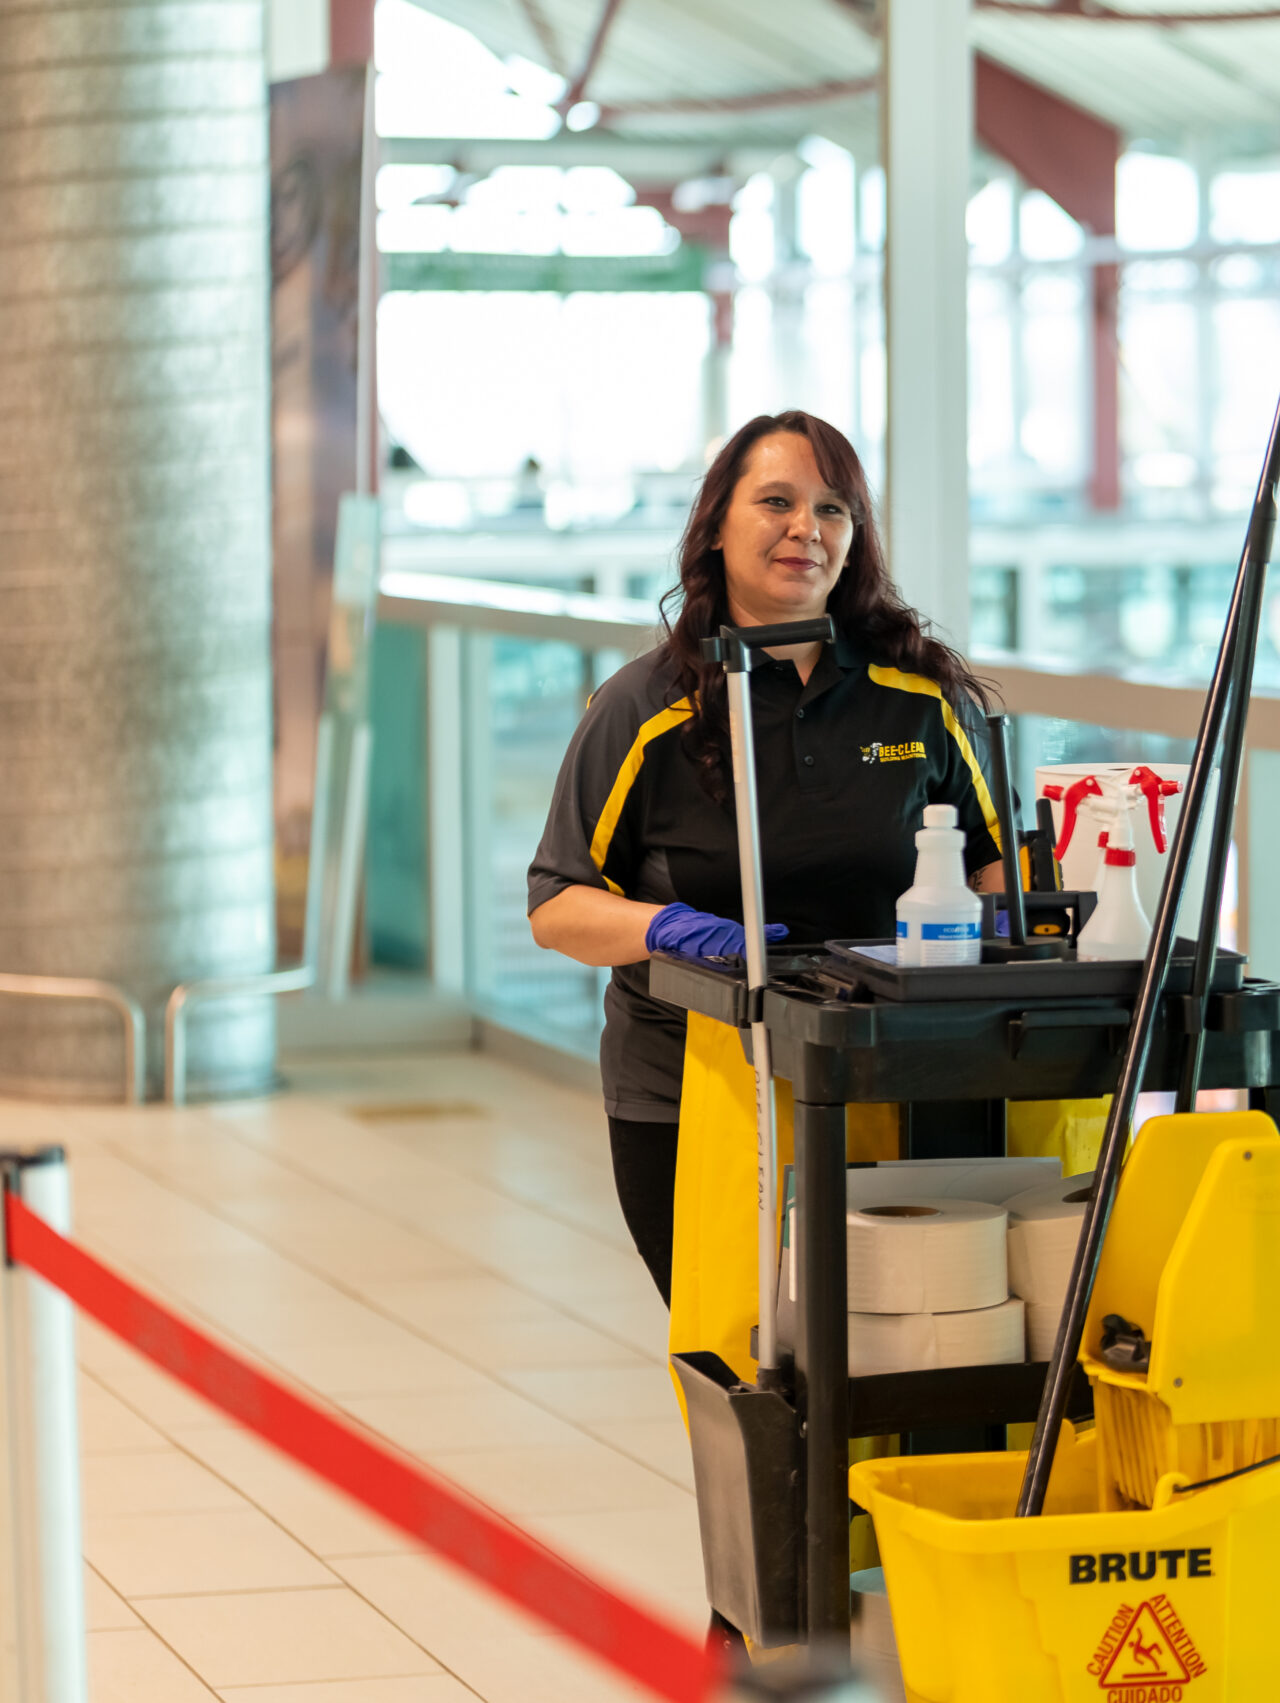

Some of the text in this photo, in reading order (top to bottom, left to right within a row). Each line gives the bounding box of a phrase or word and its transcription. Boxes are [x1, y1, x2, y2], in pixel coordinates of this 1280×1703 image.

[1069, 1548, 1212, 1585] BRUTE
[1086, 1602, 1135, 1677] CAUTION
[1149, 1594, 1208, 1679] ATTENTION
[1106, 1686, 1183, 1703] CUIDADO
